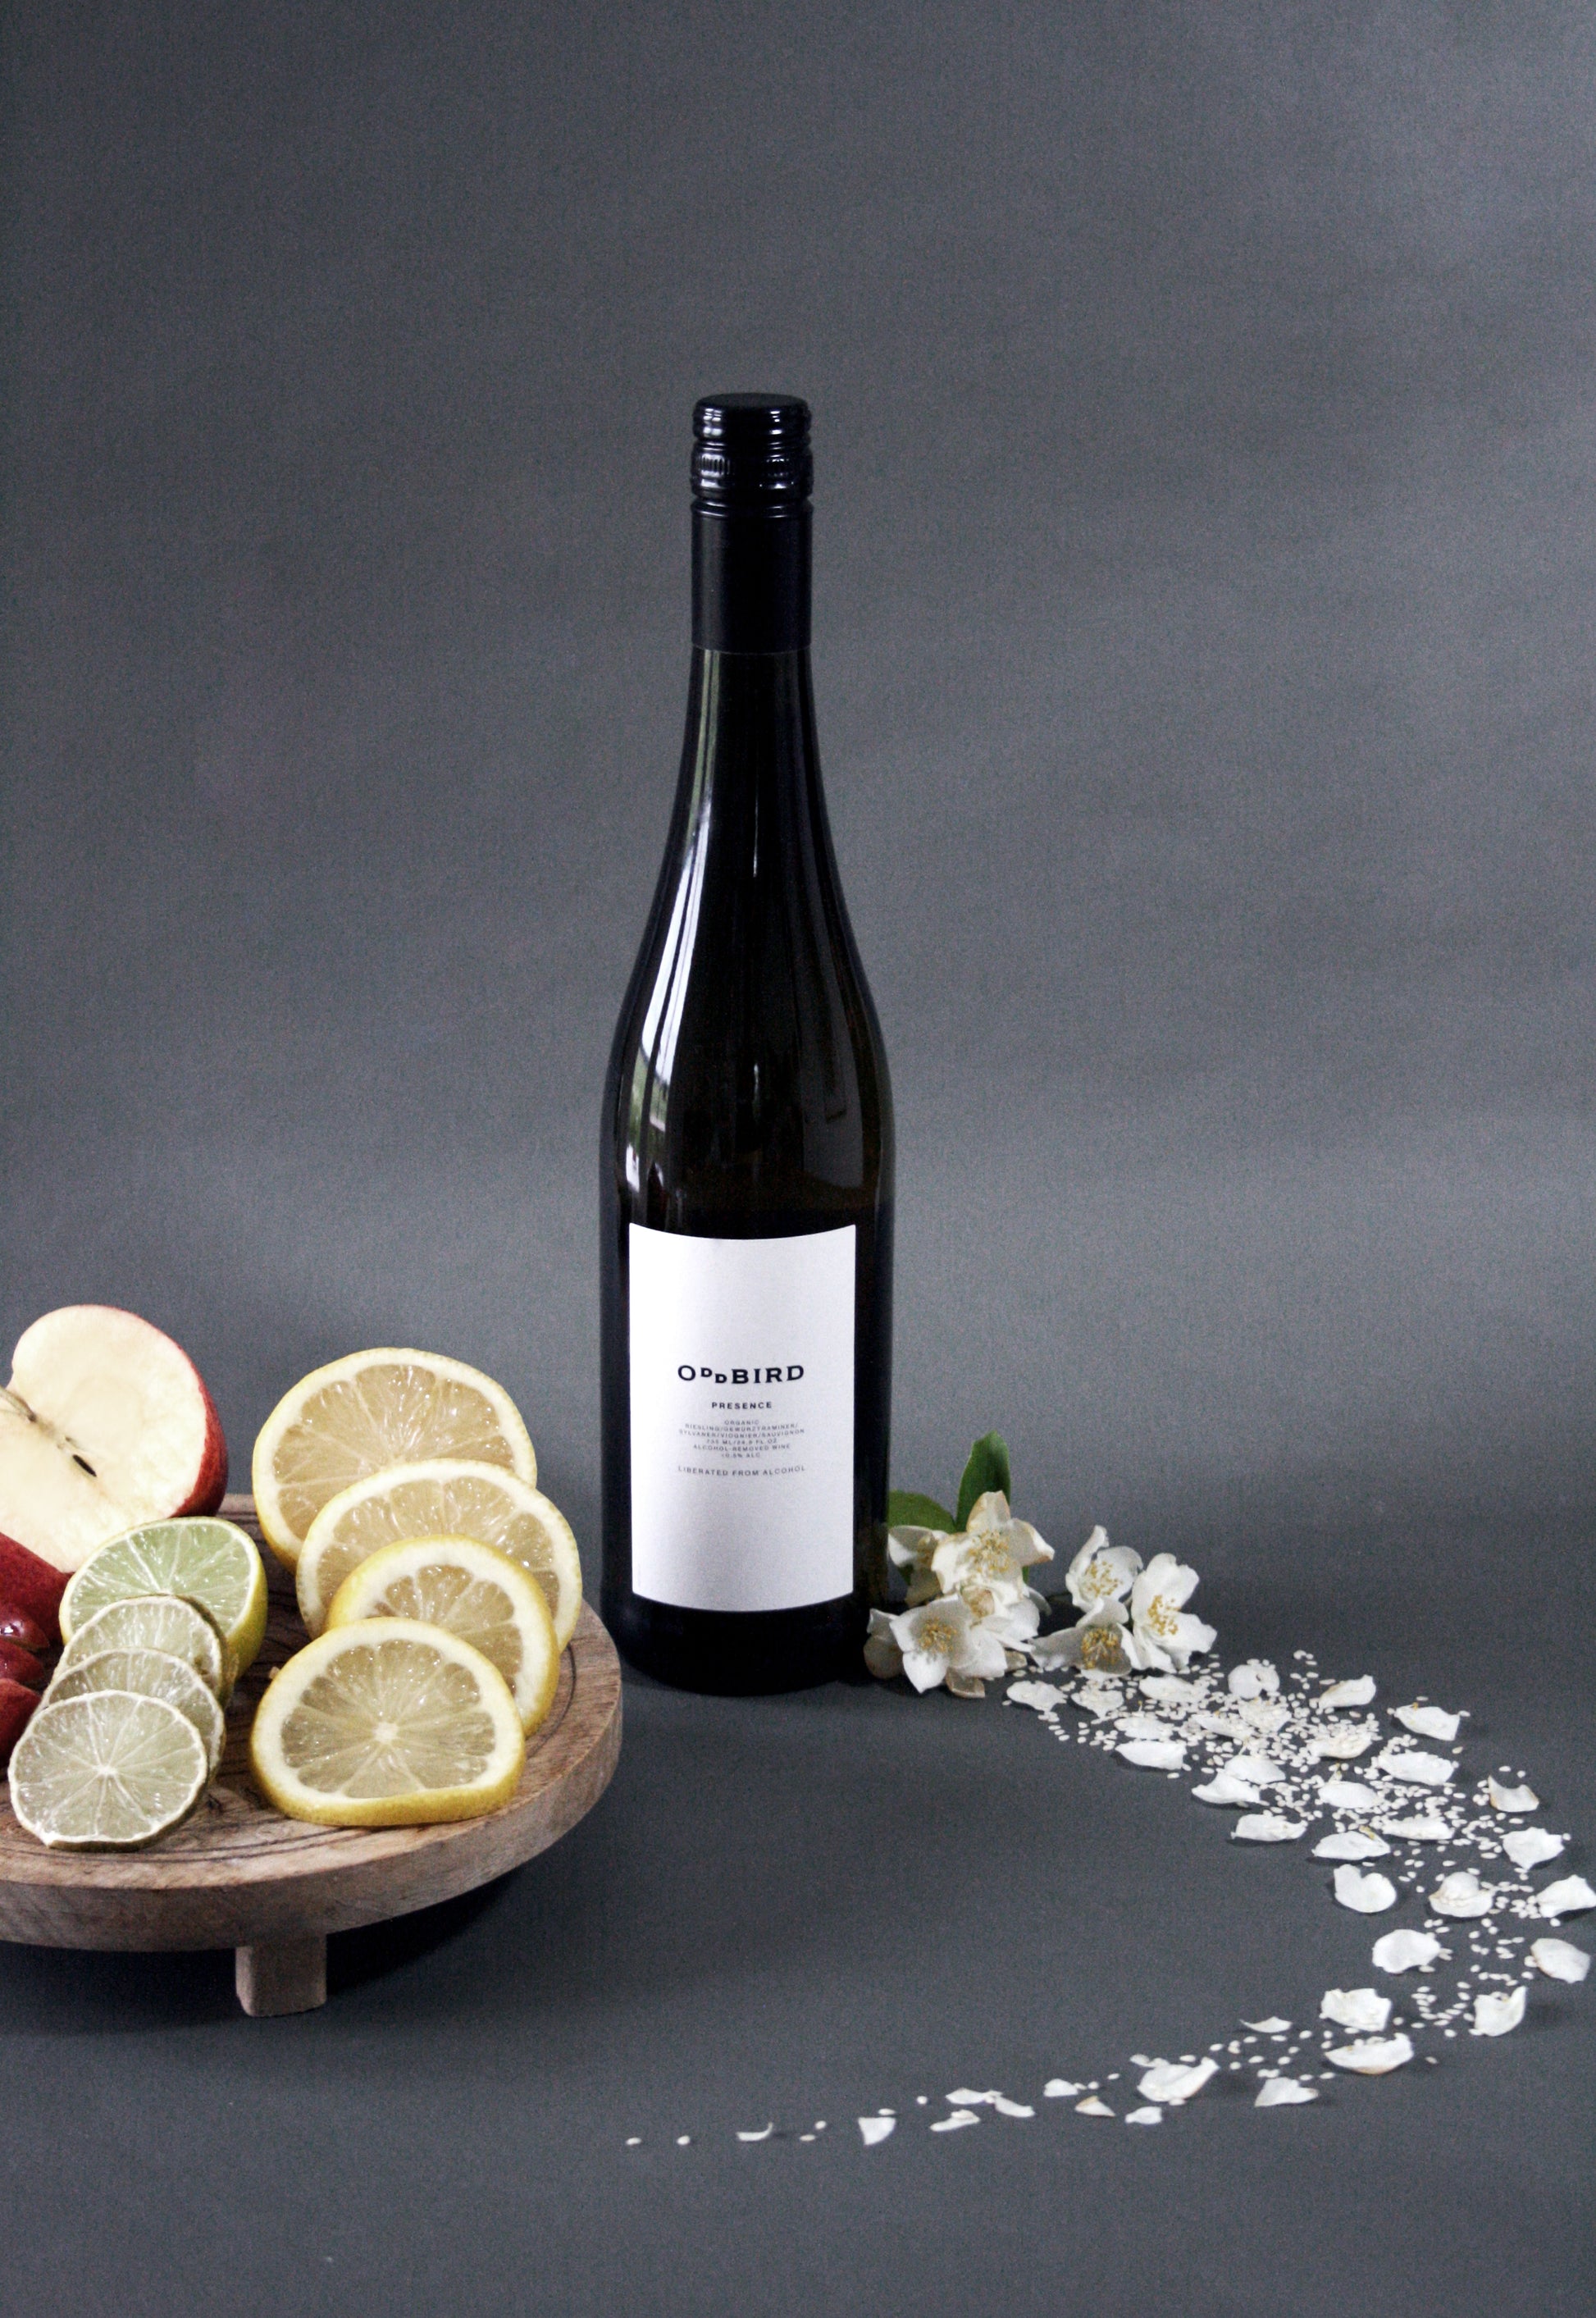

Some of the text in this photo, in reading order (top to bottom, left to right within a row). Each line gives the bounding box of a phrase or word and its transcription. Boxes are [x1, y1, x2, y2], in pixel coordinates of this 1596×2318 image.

[677, 1364, 805, 1385] ODDBIRD
[711, 1401, 772, 1410] PRESENCE
[678, 1465, 728, 1476] LIBERATED
[763, 1465, 806, 1476] ALCOHOL
